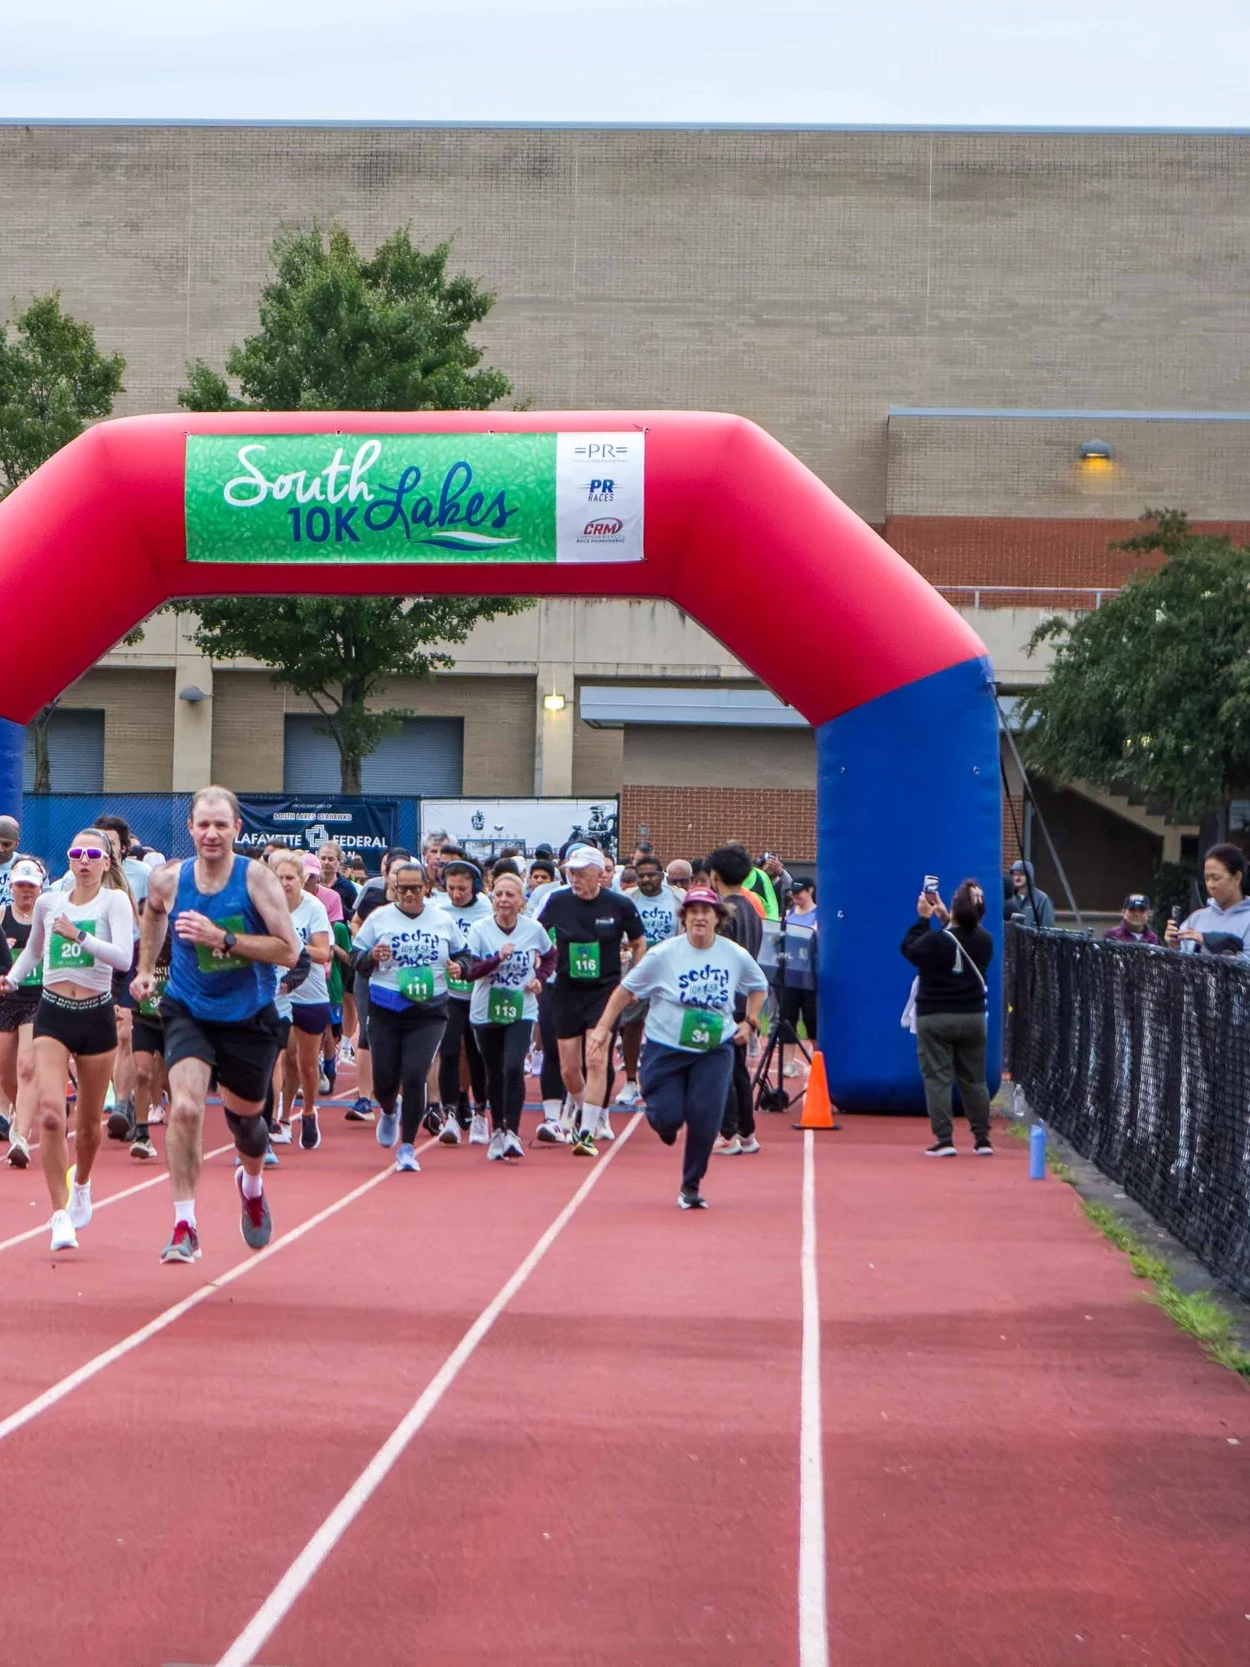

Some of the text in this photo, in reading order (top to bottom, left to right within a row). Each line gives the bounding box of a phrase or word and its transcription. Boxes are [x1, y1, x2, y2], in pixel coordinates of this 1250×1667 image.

[224, 440, 381, 506] South
[590, 479, 614, 493] PR
[364, 461, 519, 541] Lakes
[287, 505, 361, 543] 10K
[584, 523, 617, 535] CRM
[333, 834, 388, 848] FEDERAL
[642, 907, 672, 923] OUTH
[391, 929, 439, 949] SOUTH
[61, 942, 82, 958] 20
[392, 950, 439, 967] LAKES
[576, 959, 596, 971] 116
[489, 968, 529, 986] AKES
[678, 964, 729, 989] SOUTH
[407, 983, 428, 995] 111
[495, 1004, 517, 1017] 113
[691, 1029, 710, 1044] 34
